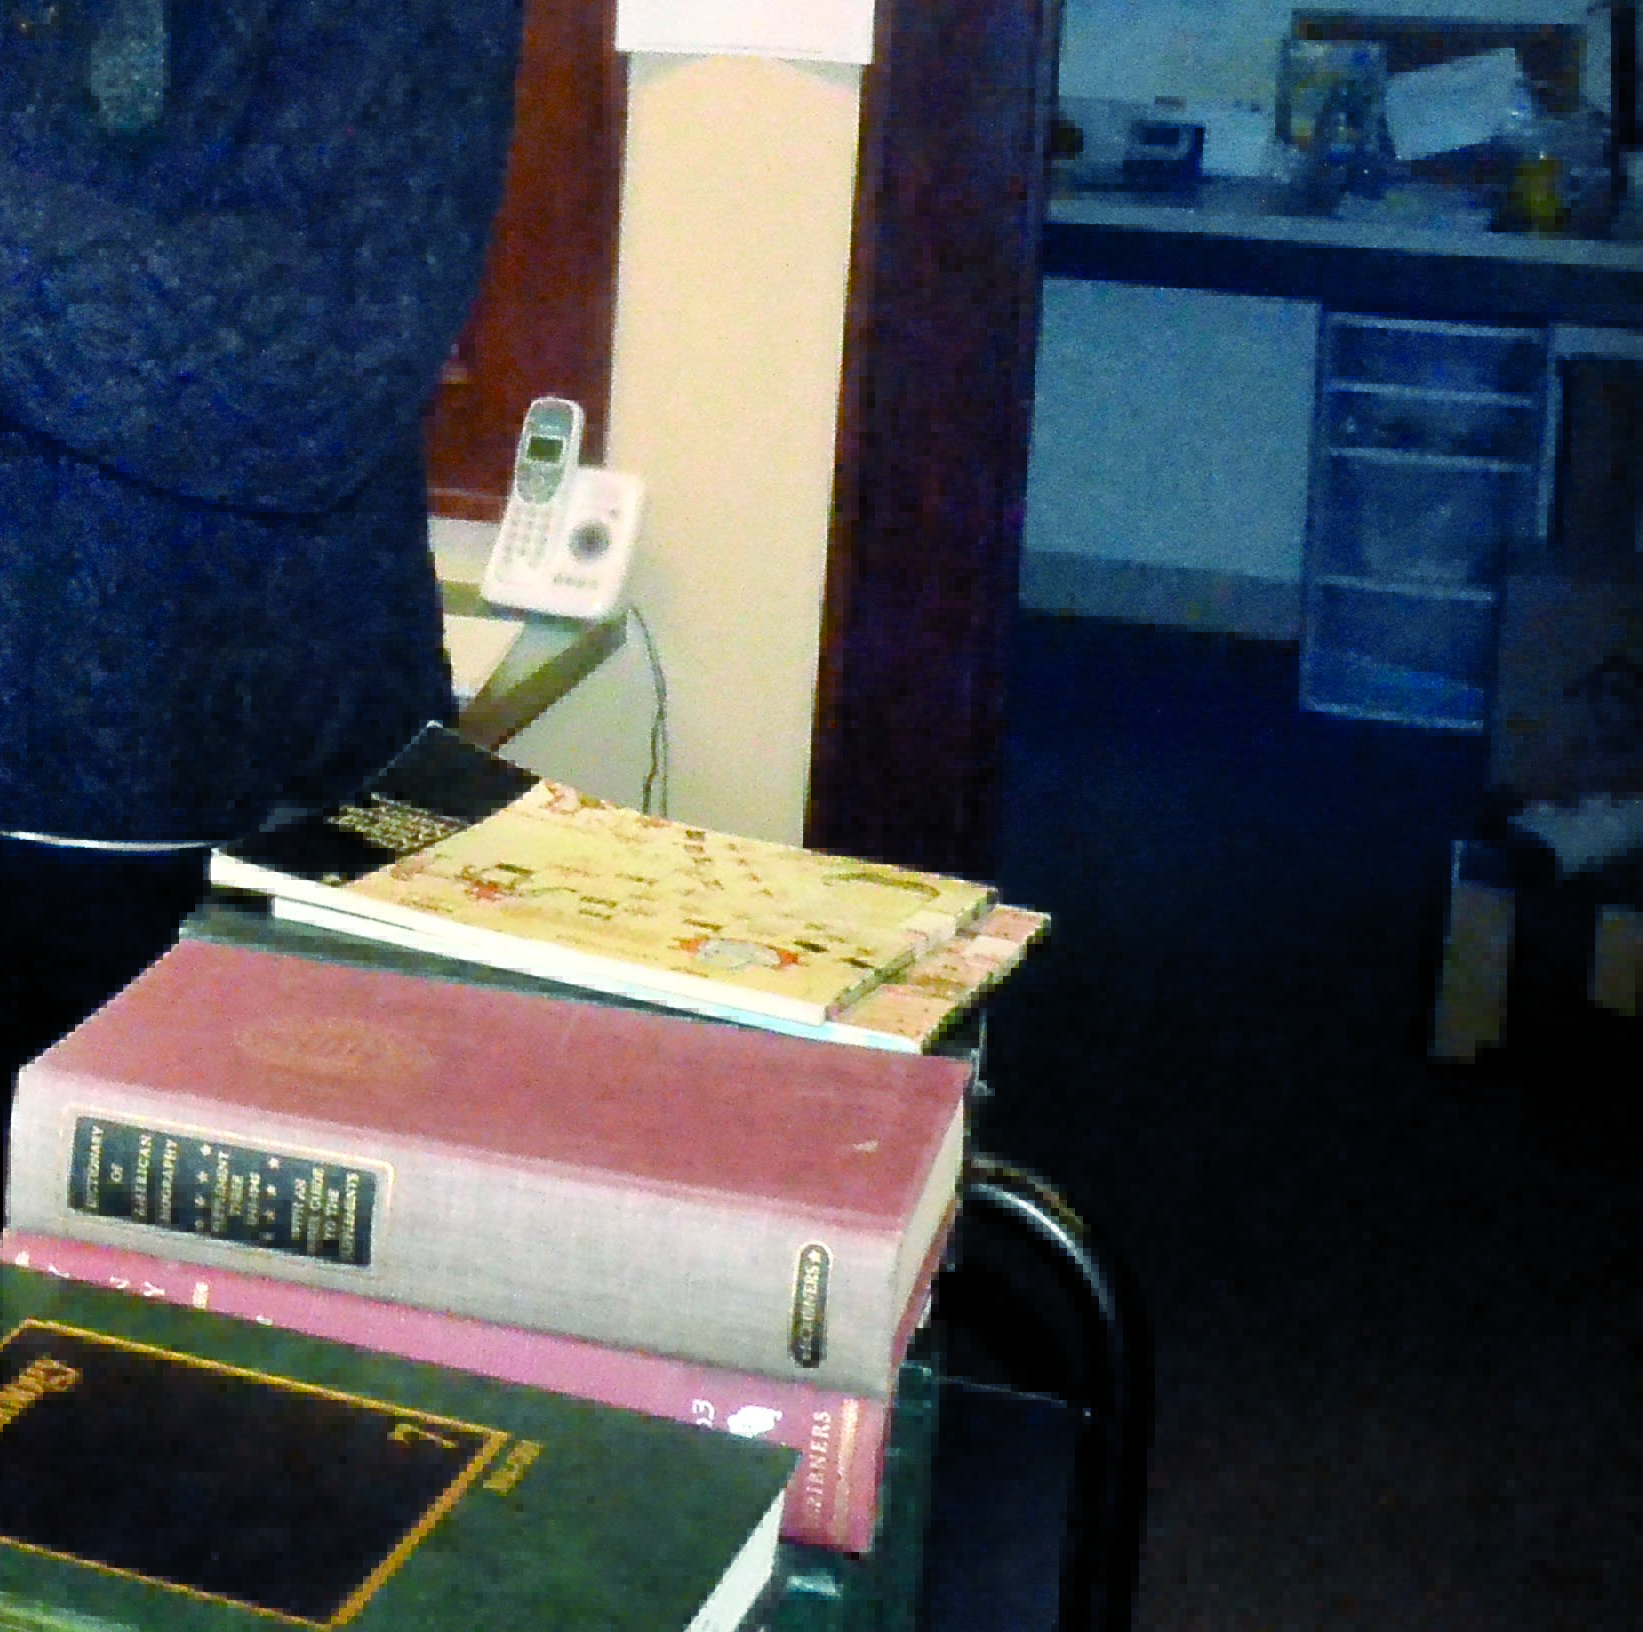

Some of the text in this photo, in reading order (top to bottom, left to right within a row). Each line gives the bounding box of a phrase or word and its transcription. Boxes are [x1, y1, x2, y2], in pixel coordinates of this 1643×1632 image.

[85, 1125, 104, 1209] DICTIONARY
[110, 1163, 124, 1183] OF
[135, 1133, 152, 1217] AMERICAN
[159, 1138, 179, 1225] BIOGRAPHY
[310, 1167, 325, 1212] GUIDE
